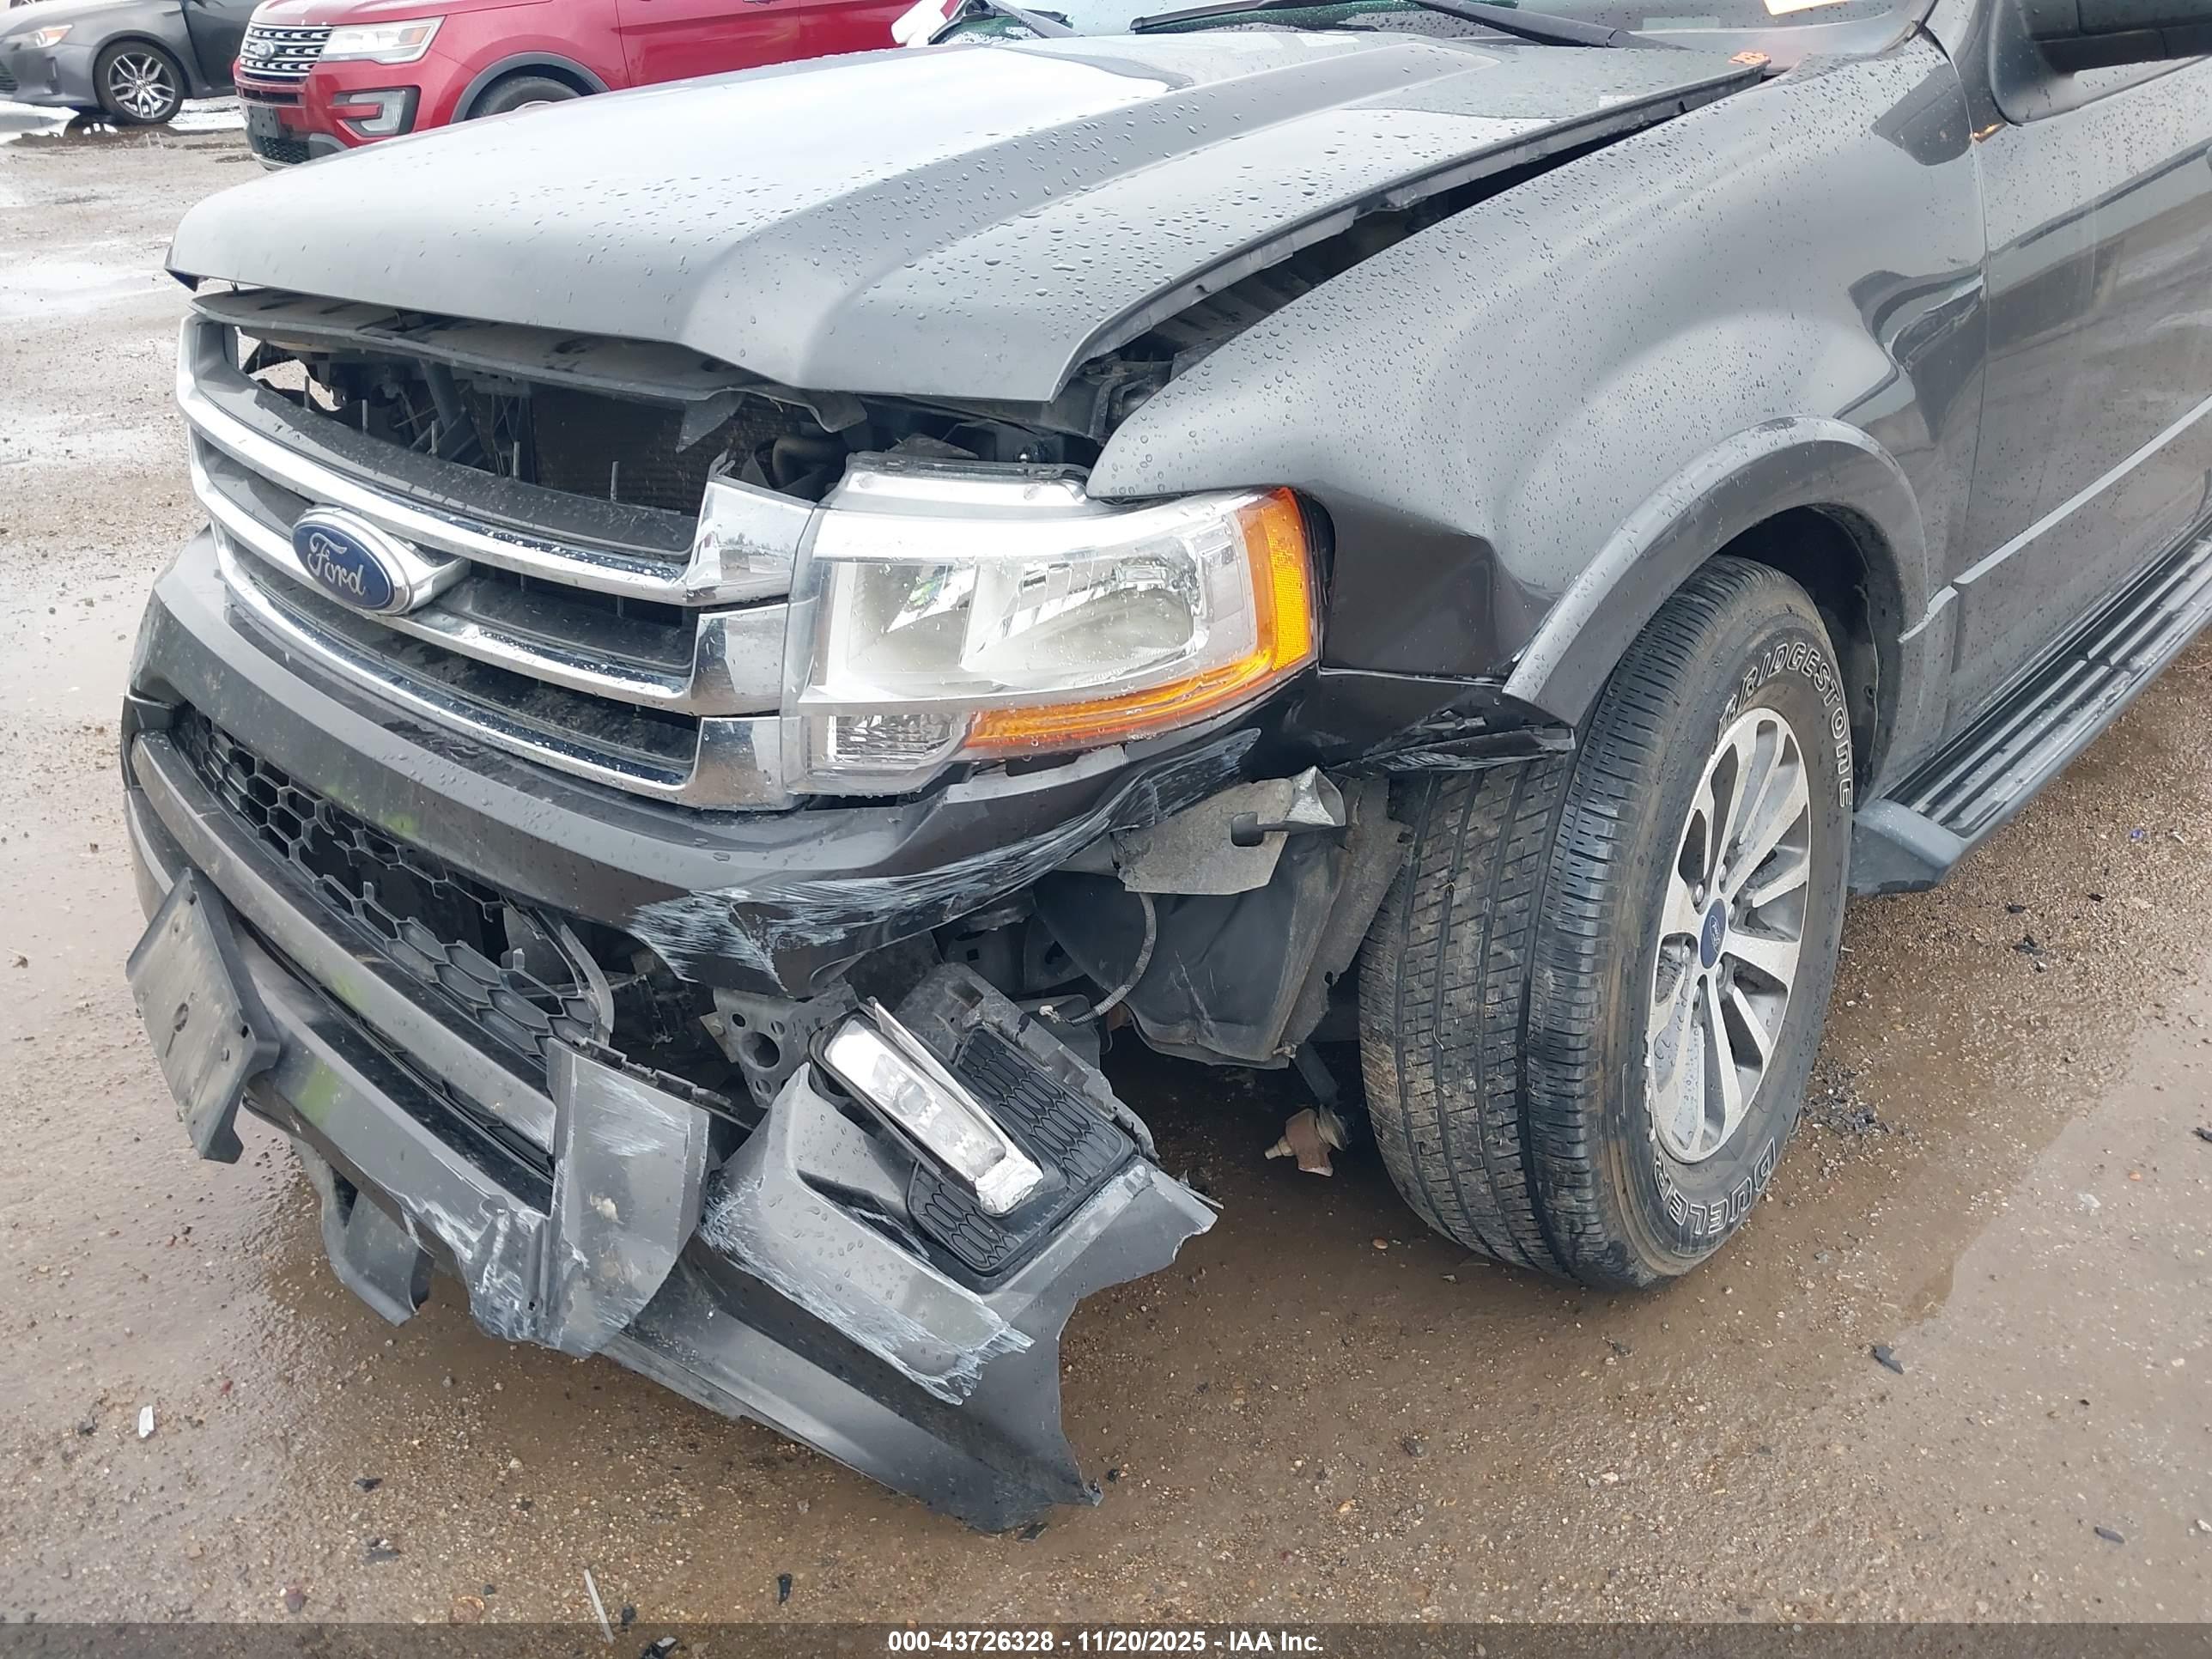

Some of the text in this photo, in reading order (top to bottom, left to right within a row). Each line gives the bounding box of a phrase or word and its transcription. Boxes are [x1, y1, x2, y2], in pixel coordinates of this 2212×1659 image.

[307, 532, 367, 597] Ford
[1718, 641, 1853, 808] BRIDGESTONE
[1653, 1135, 1778, 1237] DUELER
